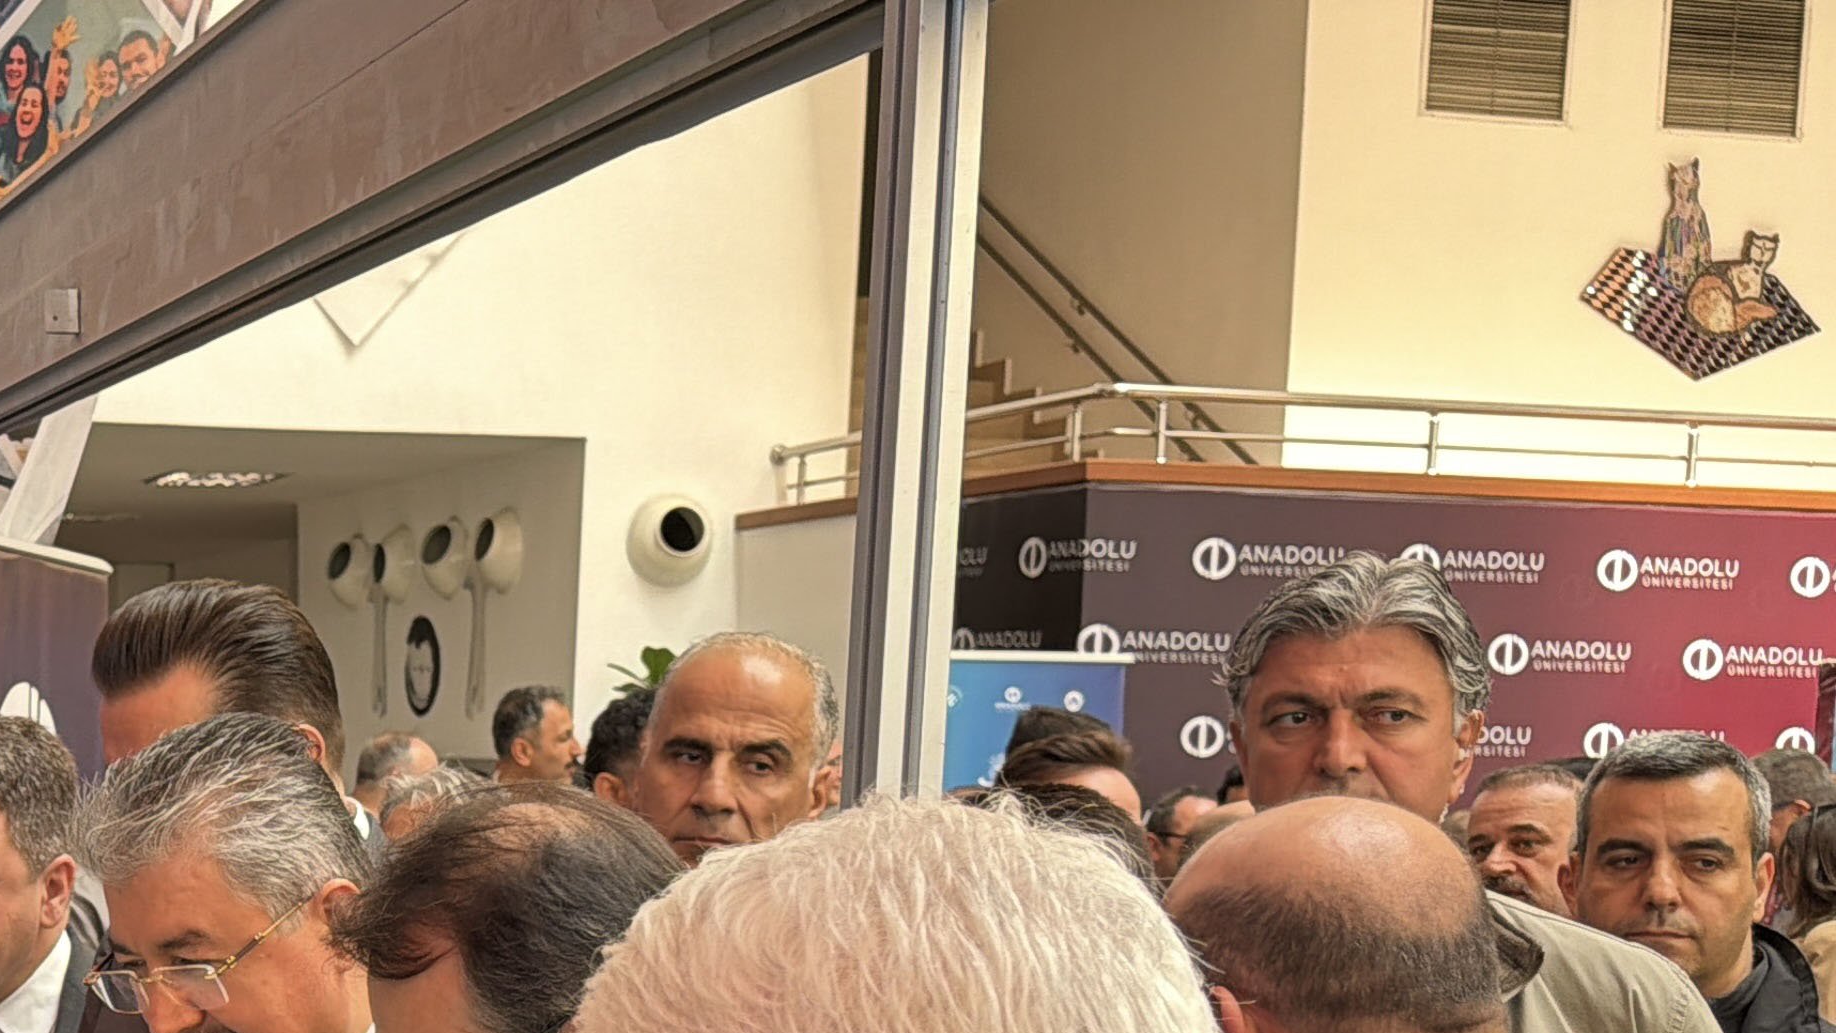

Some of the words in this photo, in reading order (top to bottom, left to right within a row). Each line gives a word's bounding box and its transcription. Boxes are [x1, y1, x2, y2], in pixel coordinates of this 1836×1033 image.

[1048, 538, 1138, 560] ANADOLU
[1442, 550, 1546, 572] ANADOLU
[1640, 556, 1740, 579] ANADOLU
[1122, 630, 1232, 651] ANADOLU
[1530, 640, 1632, 661] ANADOLU
[1725, 646, 1823, 666] ANADOLU
